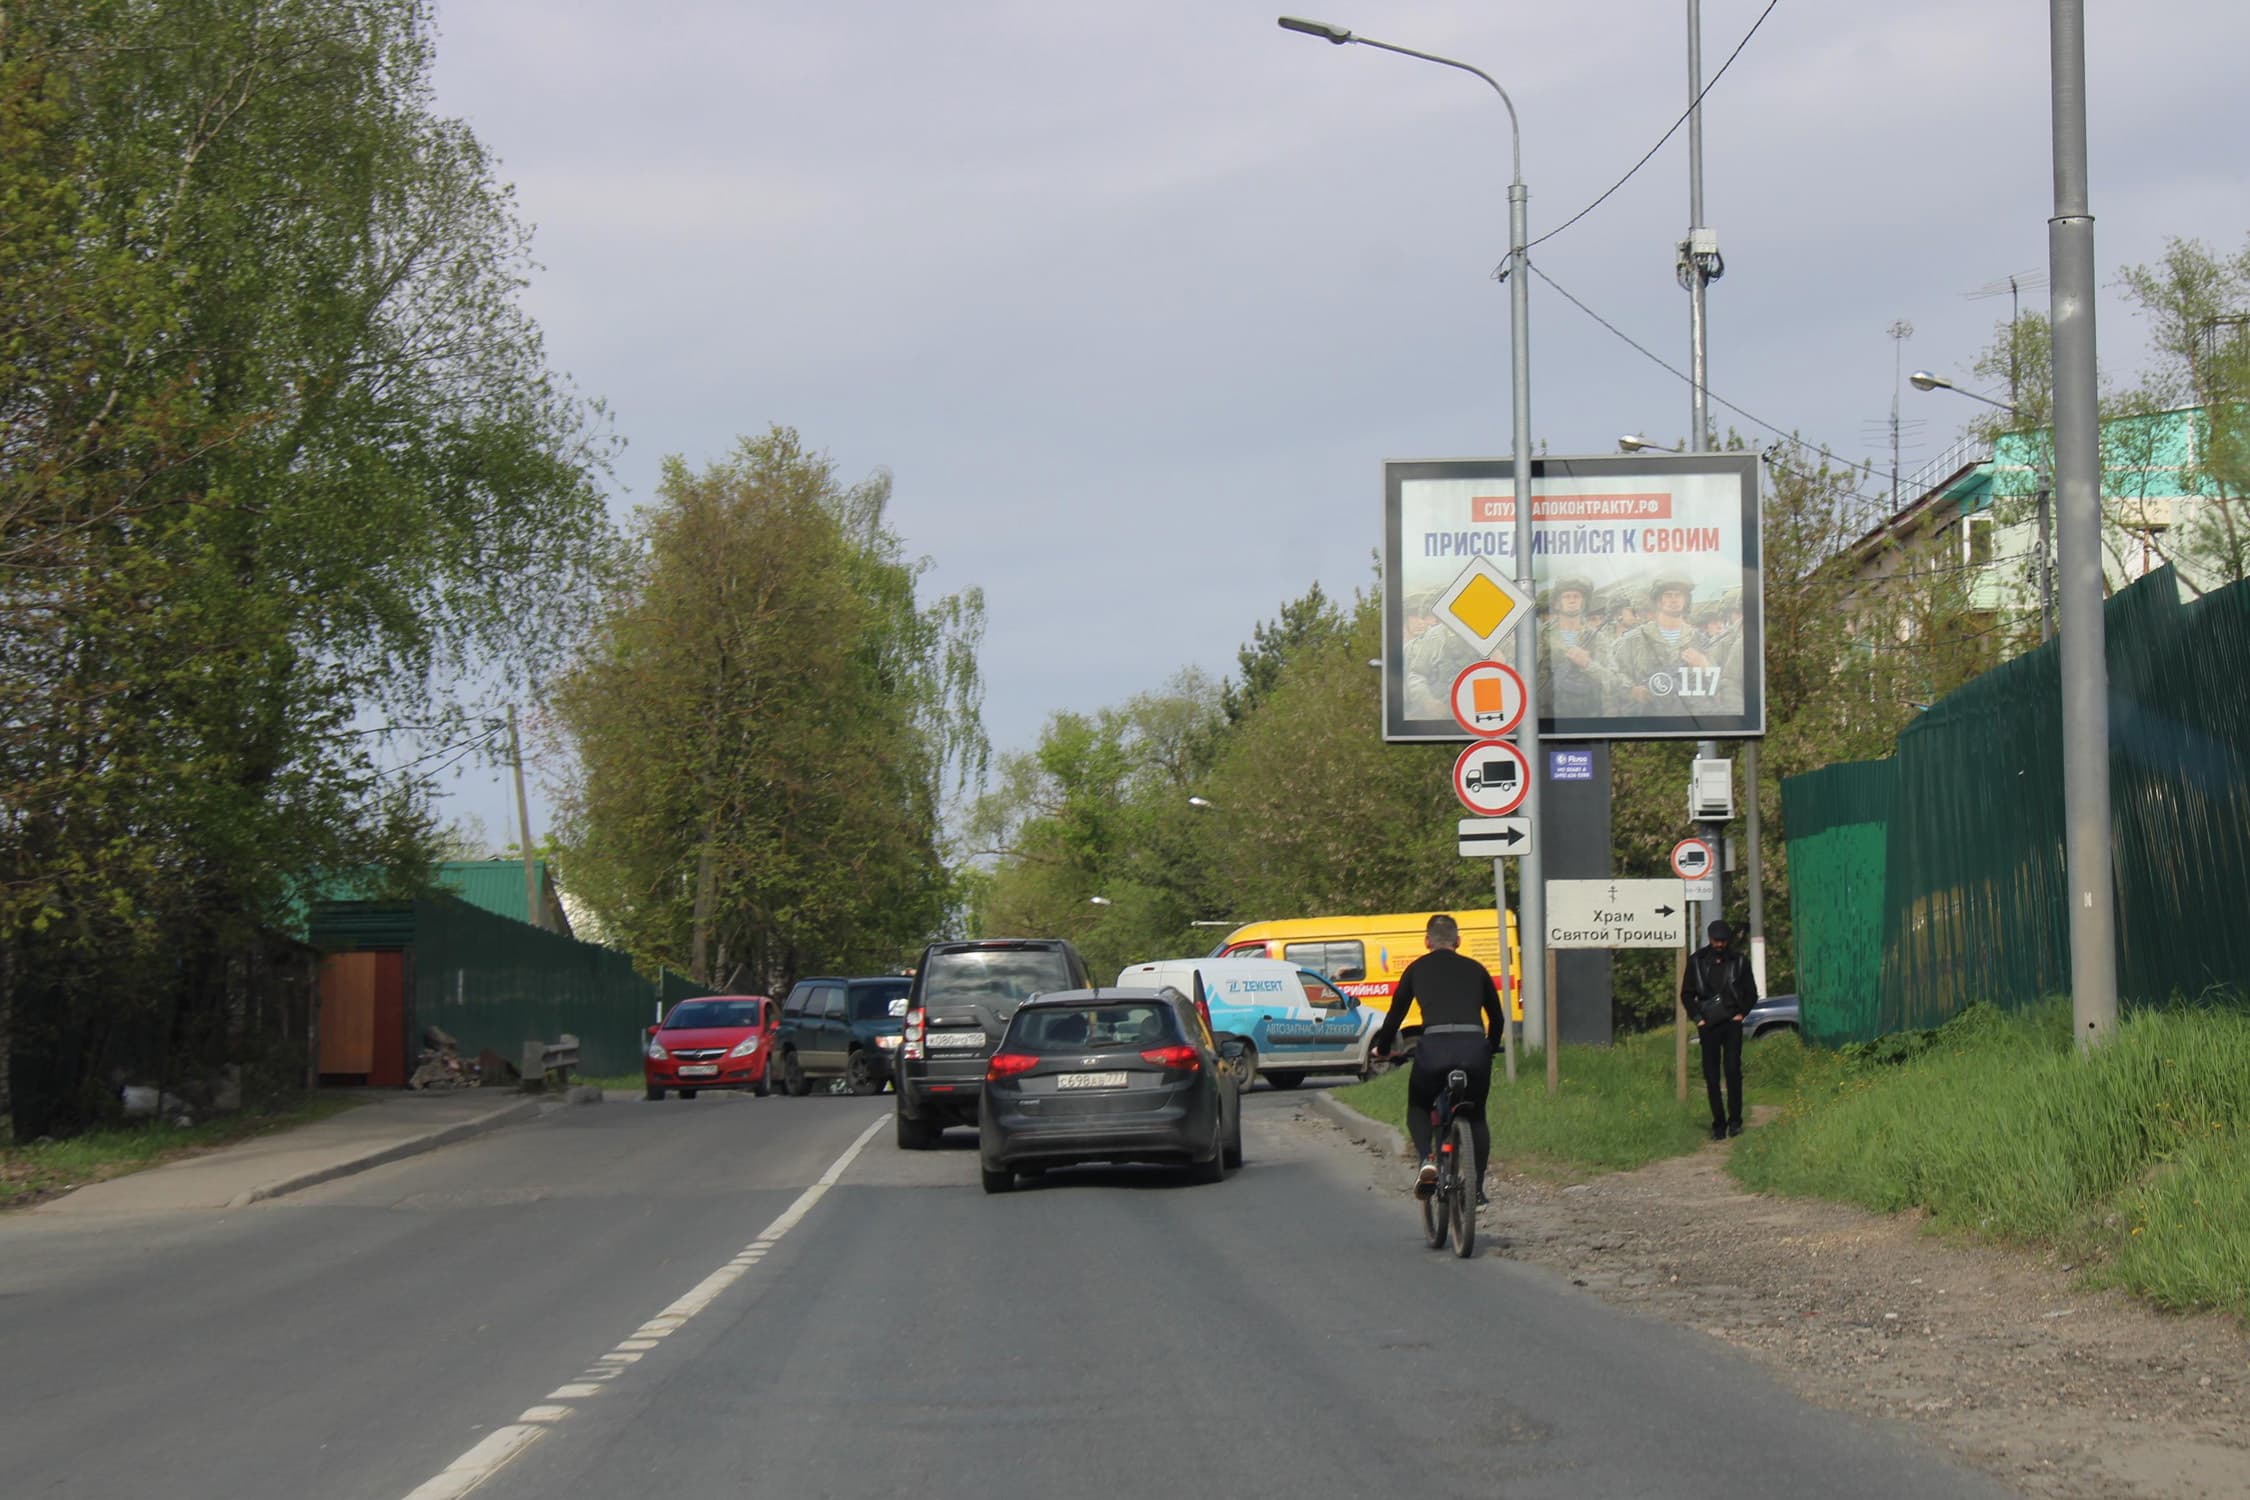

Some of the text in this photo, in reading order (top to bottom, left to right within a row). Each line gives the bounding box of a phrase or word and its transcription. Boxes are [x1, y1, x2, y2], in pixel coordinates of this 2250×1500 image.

[1484, 499, 1659, 517] СЛУАПОКОНТРАКТУ.РФ
[1424, 524, 1720, 557] ПРИСОЕИНЯЙСЯ К СВОИМ
[1678, 666, 1721, 697] 117
[1593, 909, 1635, 925] Храм
[1551, 927, 1677, 944] Святой Троицы
